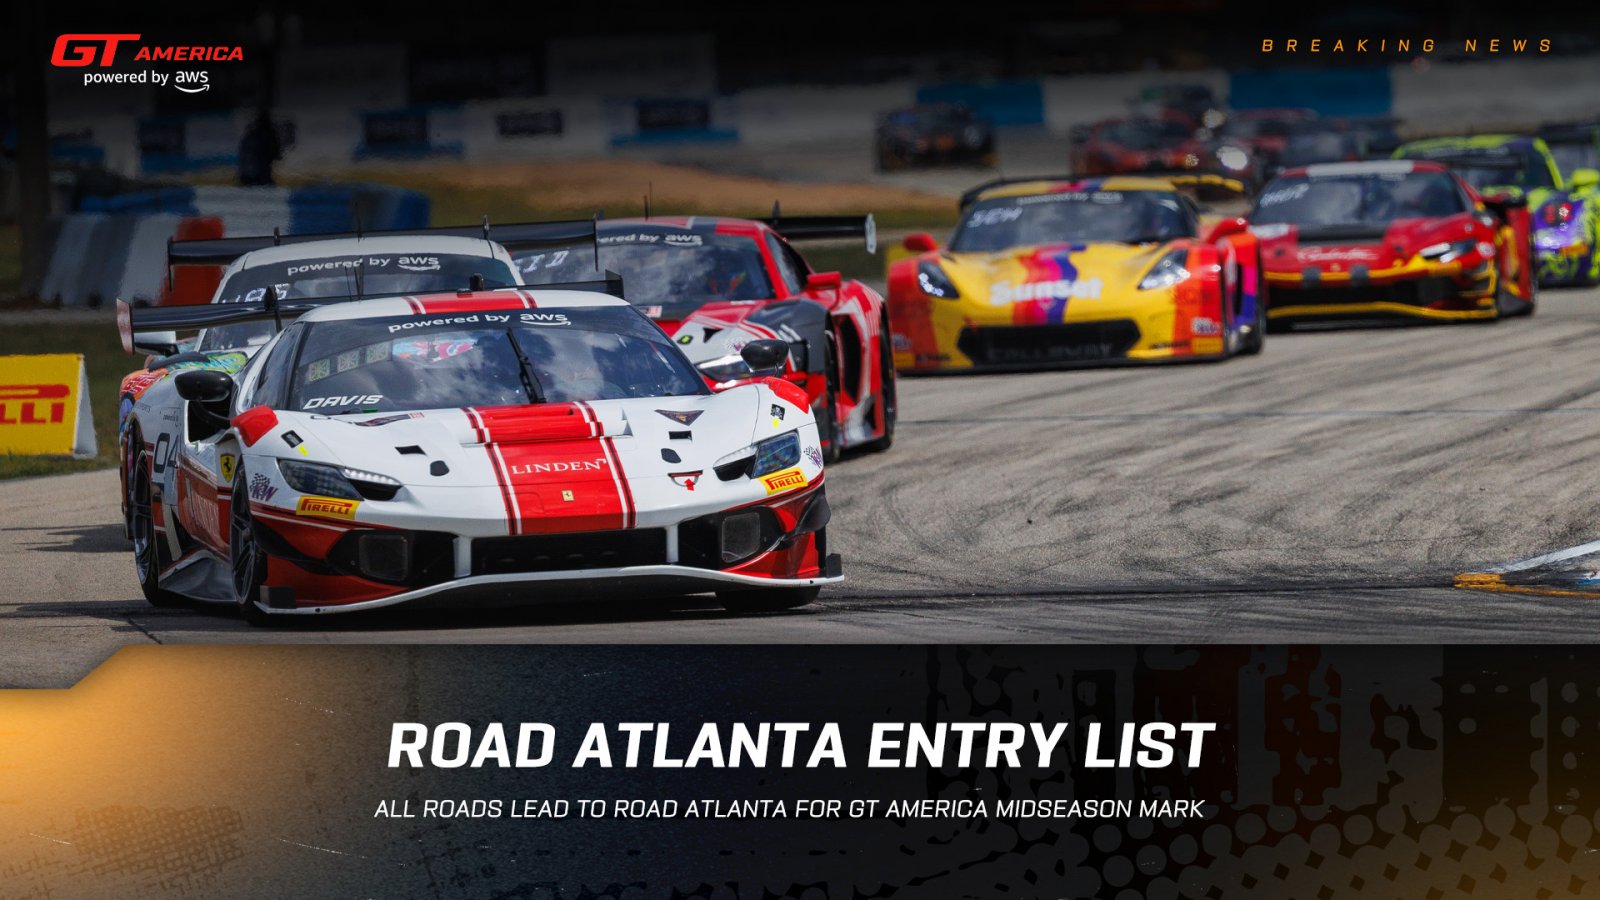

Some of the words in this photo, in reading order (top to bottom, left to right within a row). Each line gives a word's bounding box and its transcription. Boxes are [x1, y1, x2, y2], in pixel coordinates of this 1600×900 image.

[287, 258, 364, 277] powered
[369, 257, 391, 267] by
[398, 256, 440, 266] aws
[388, 314, 478, 334] powered
[485, 313, 511, 324] by
[519, 313, 568, 323] aws
[302, 394, 384, 411] DAVIS
[511, 460, 601, 475] LINDEN
[764, 471, 805, 491] PIRELLI
[300, 498, 353, 516] PIRELLI
